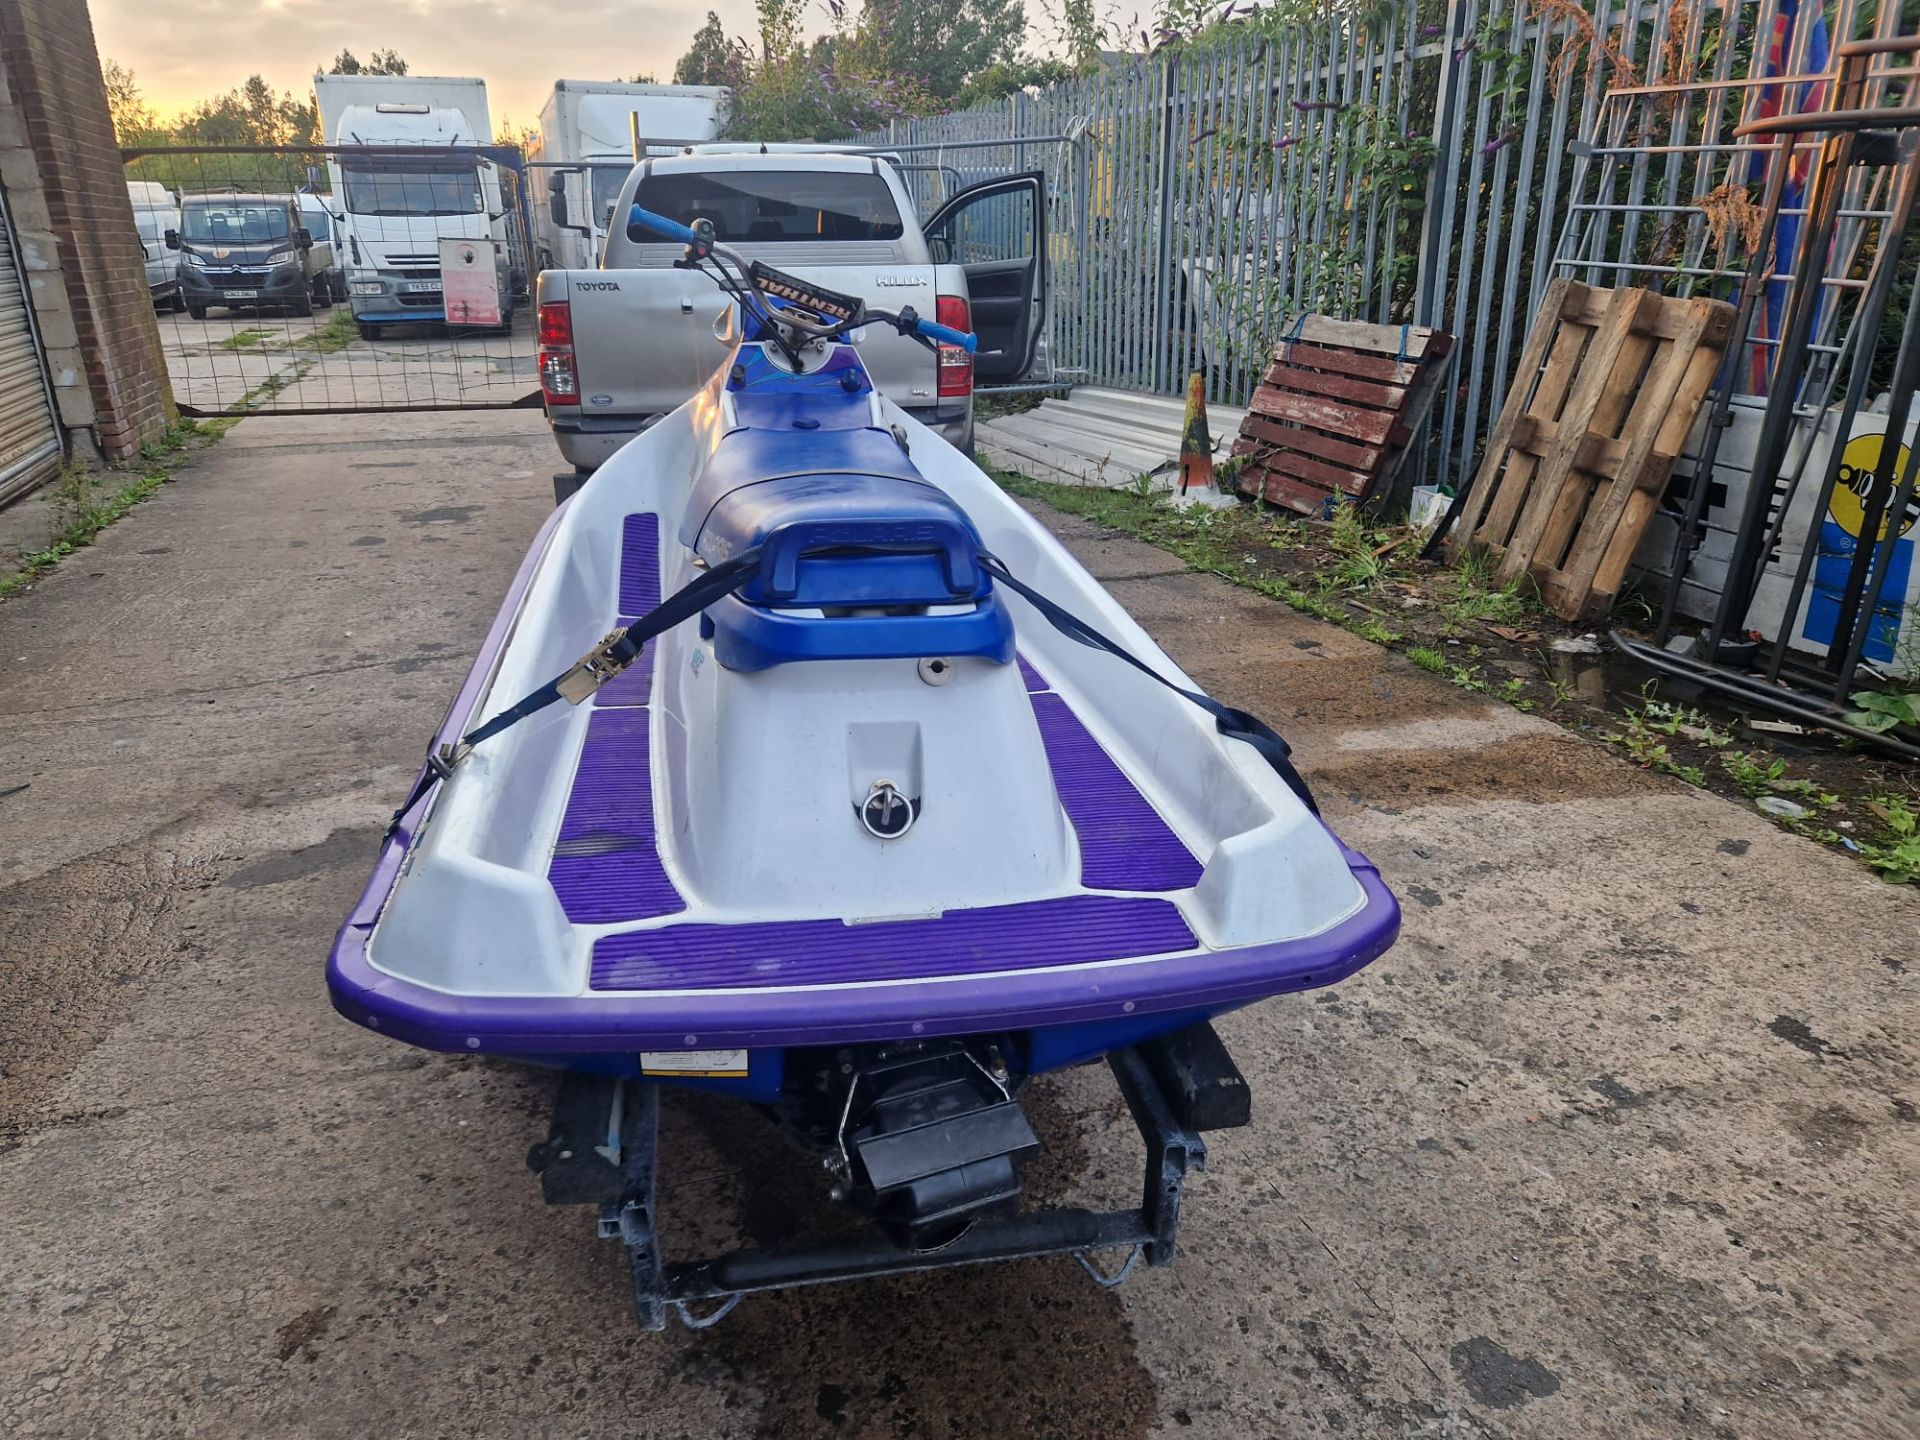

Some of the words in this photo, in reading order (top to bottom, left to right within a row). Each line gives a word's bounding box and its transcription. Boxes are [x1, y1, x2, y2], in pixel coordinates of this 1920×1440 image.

[575, 281, 622, 292] TOYOTA
[876, 274, 928, 287] HILUX
[755, 275, 852, 320] RENTHAL
